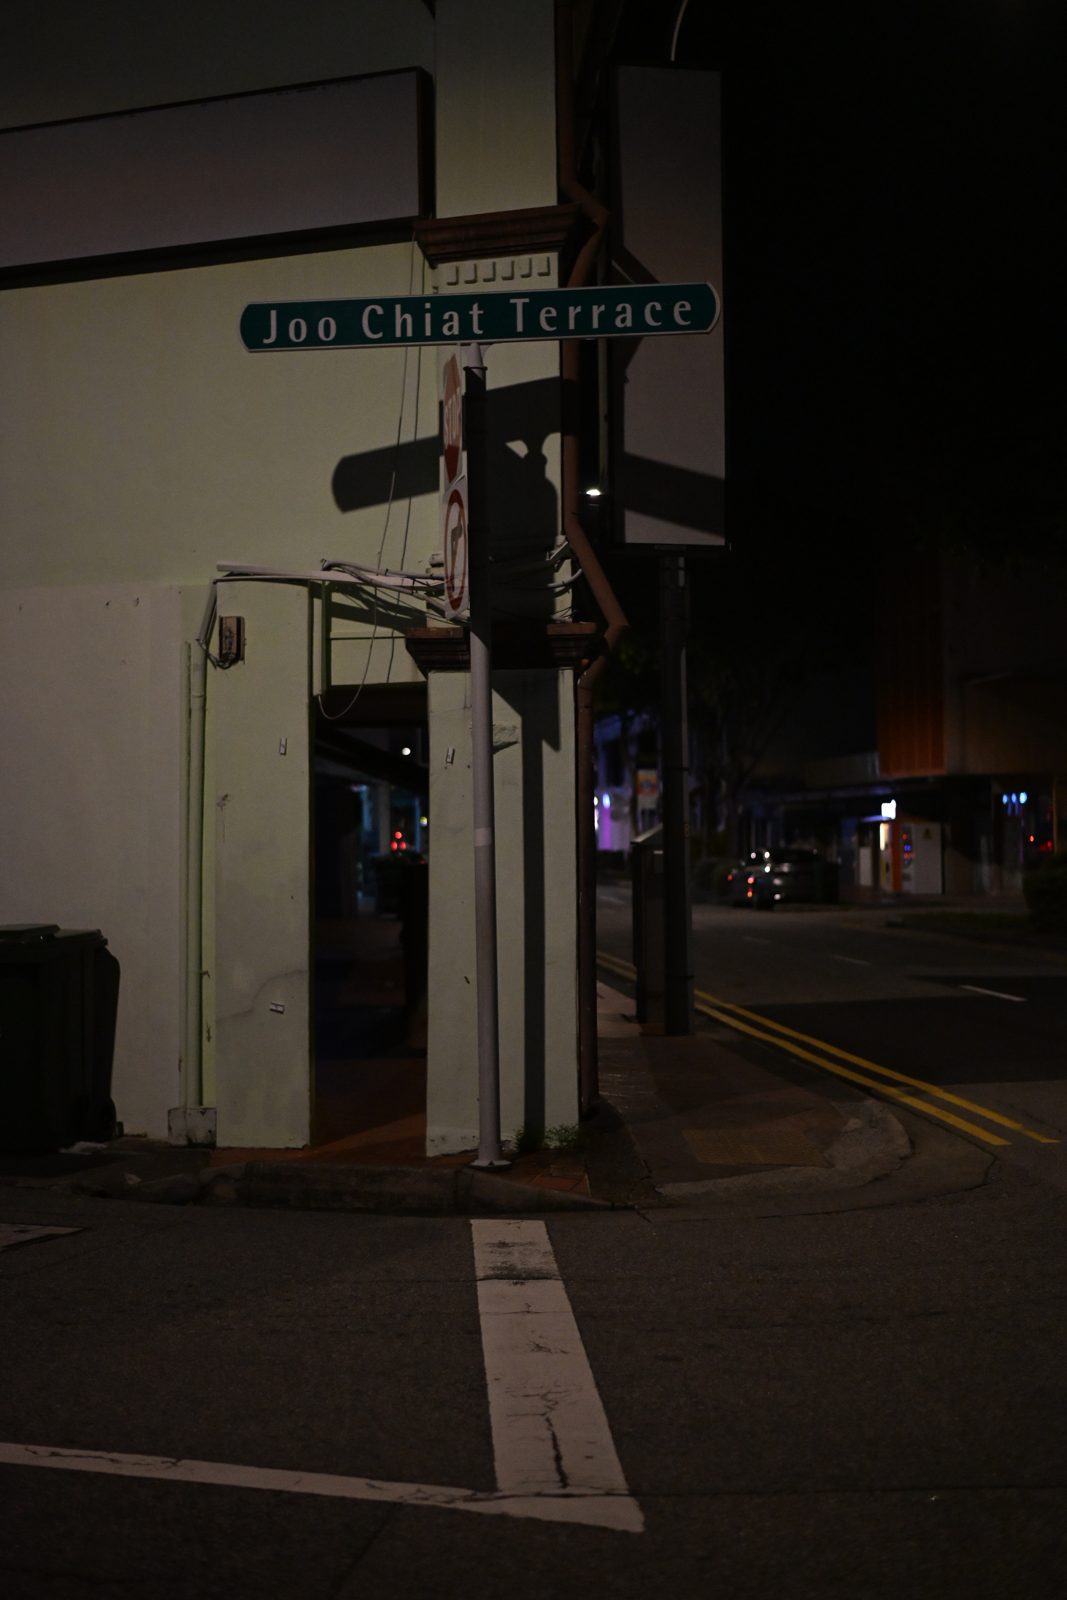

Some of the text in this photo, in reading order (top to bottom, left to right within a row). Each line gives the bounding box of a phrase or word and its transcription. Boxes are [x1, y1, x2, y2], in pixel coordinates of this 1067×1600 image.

[262, 298, 693, 345] Joo Chiat Terrace
